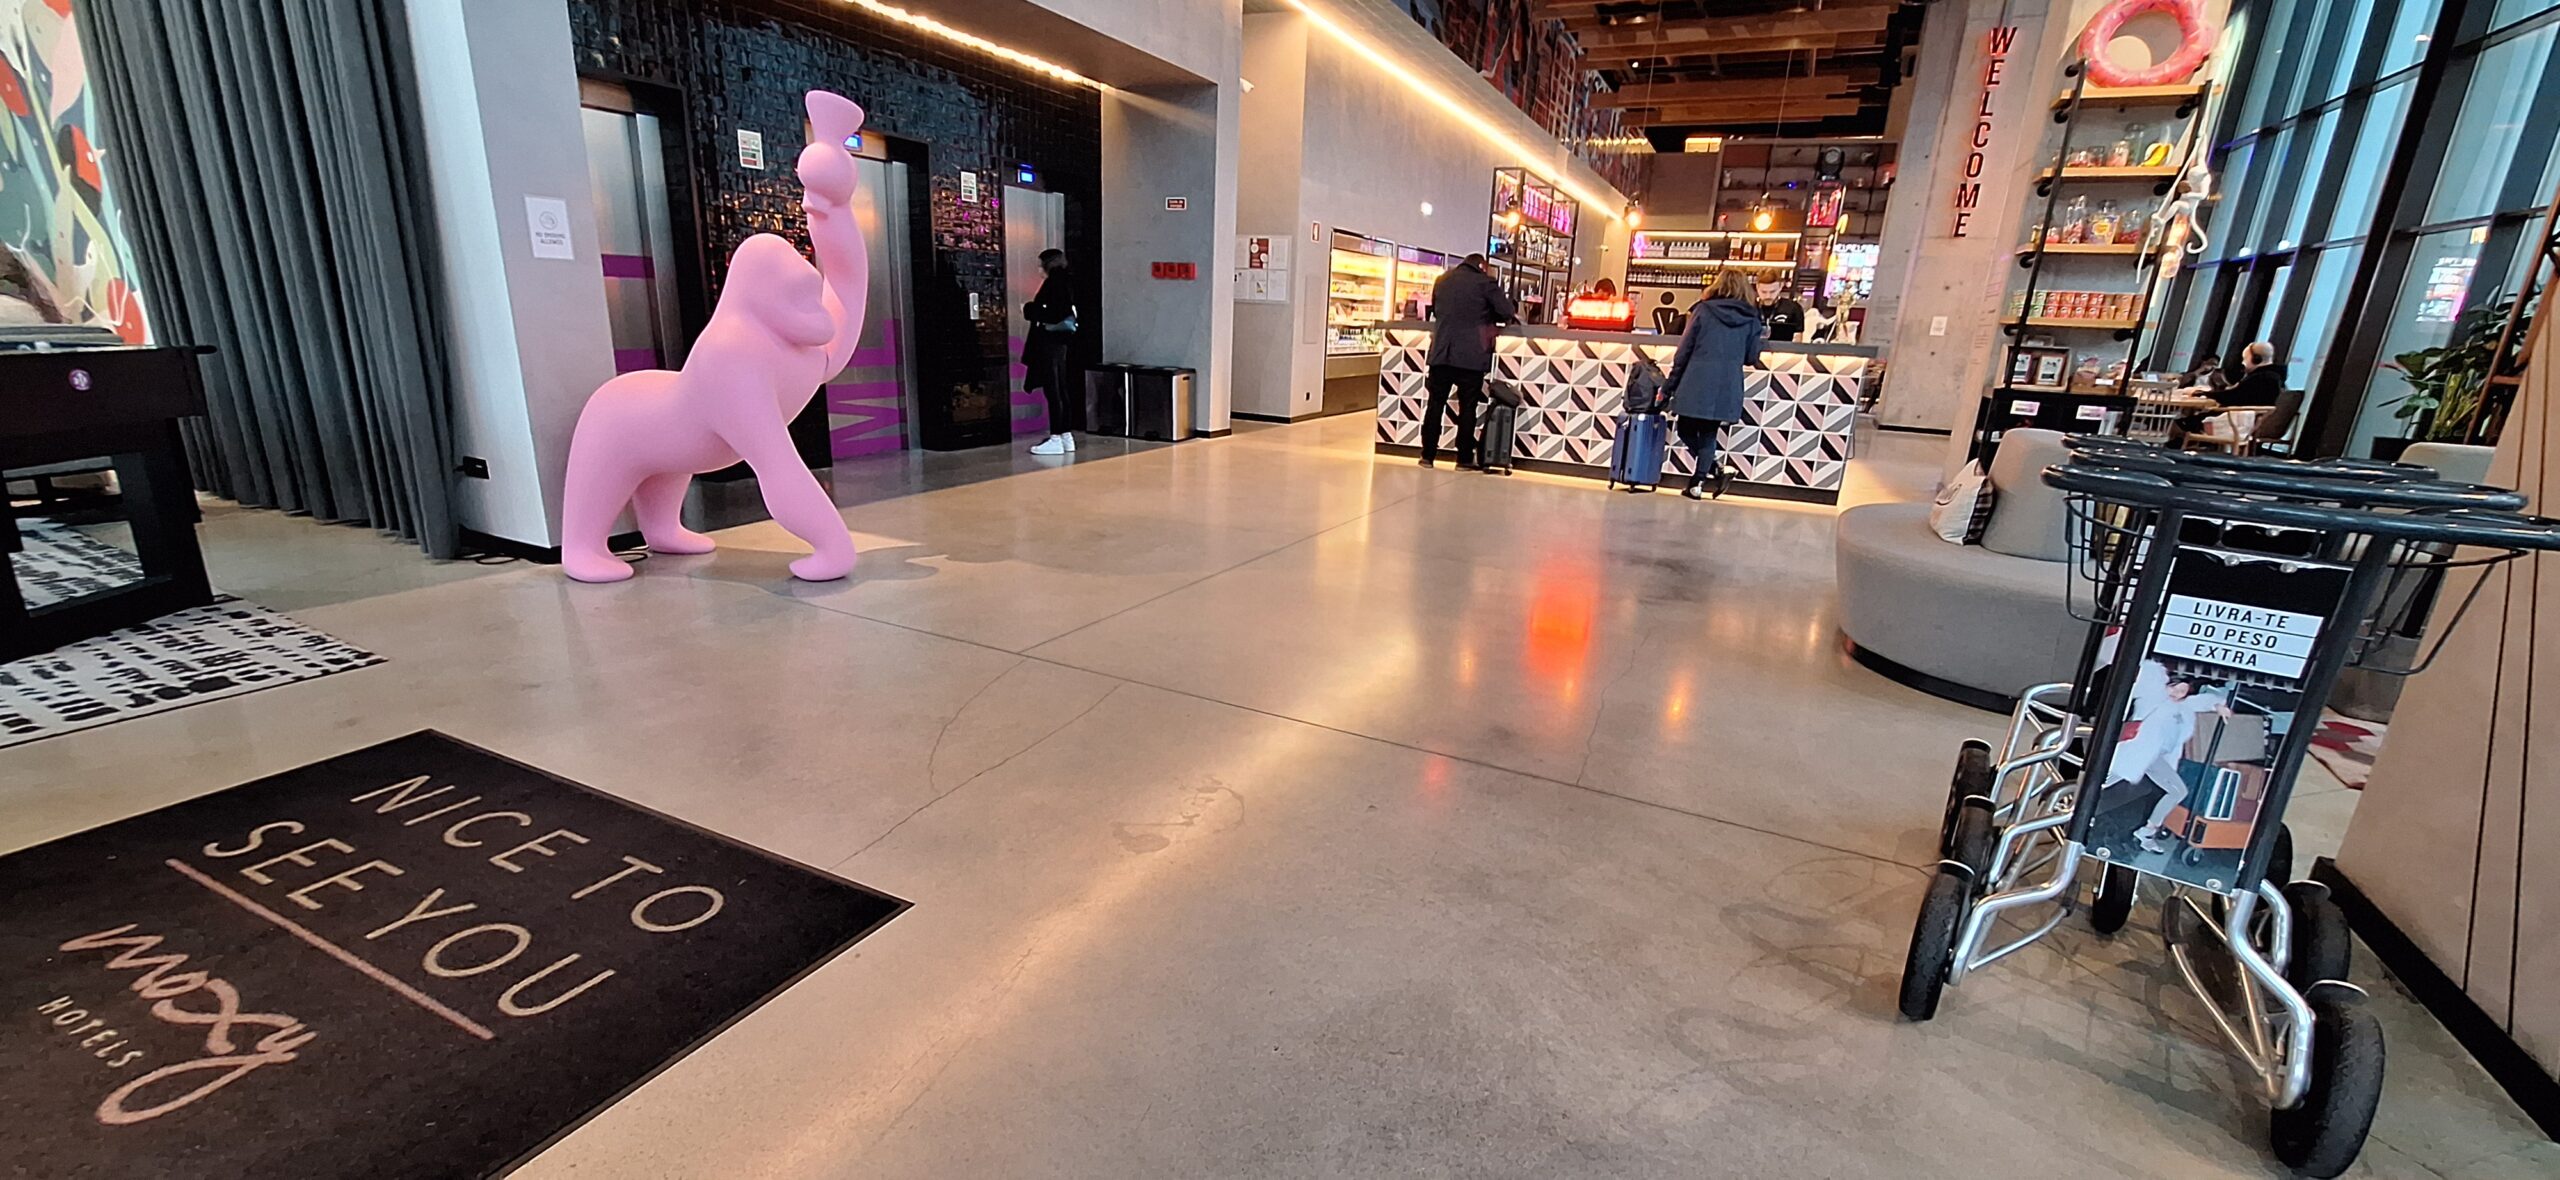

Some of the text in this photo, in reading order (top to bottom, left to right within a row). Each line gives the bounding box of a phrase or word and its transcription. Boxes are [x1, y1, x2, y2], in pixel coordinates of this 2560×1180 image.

[1953, 26, 2018, 238] WELCOME
[2189, 623, 2278, 649] DO PESO
[2194, 602, 2290, 629] LIVRA-TE
[2194, 644, 2258, 667] EXTRA
[350, 774, 725, 933] NICE TO
[203, 820, 616, 1018] SEE YOU
[37, 995, 144, 1067] HOTELS
